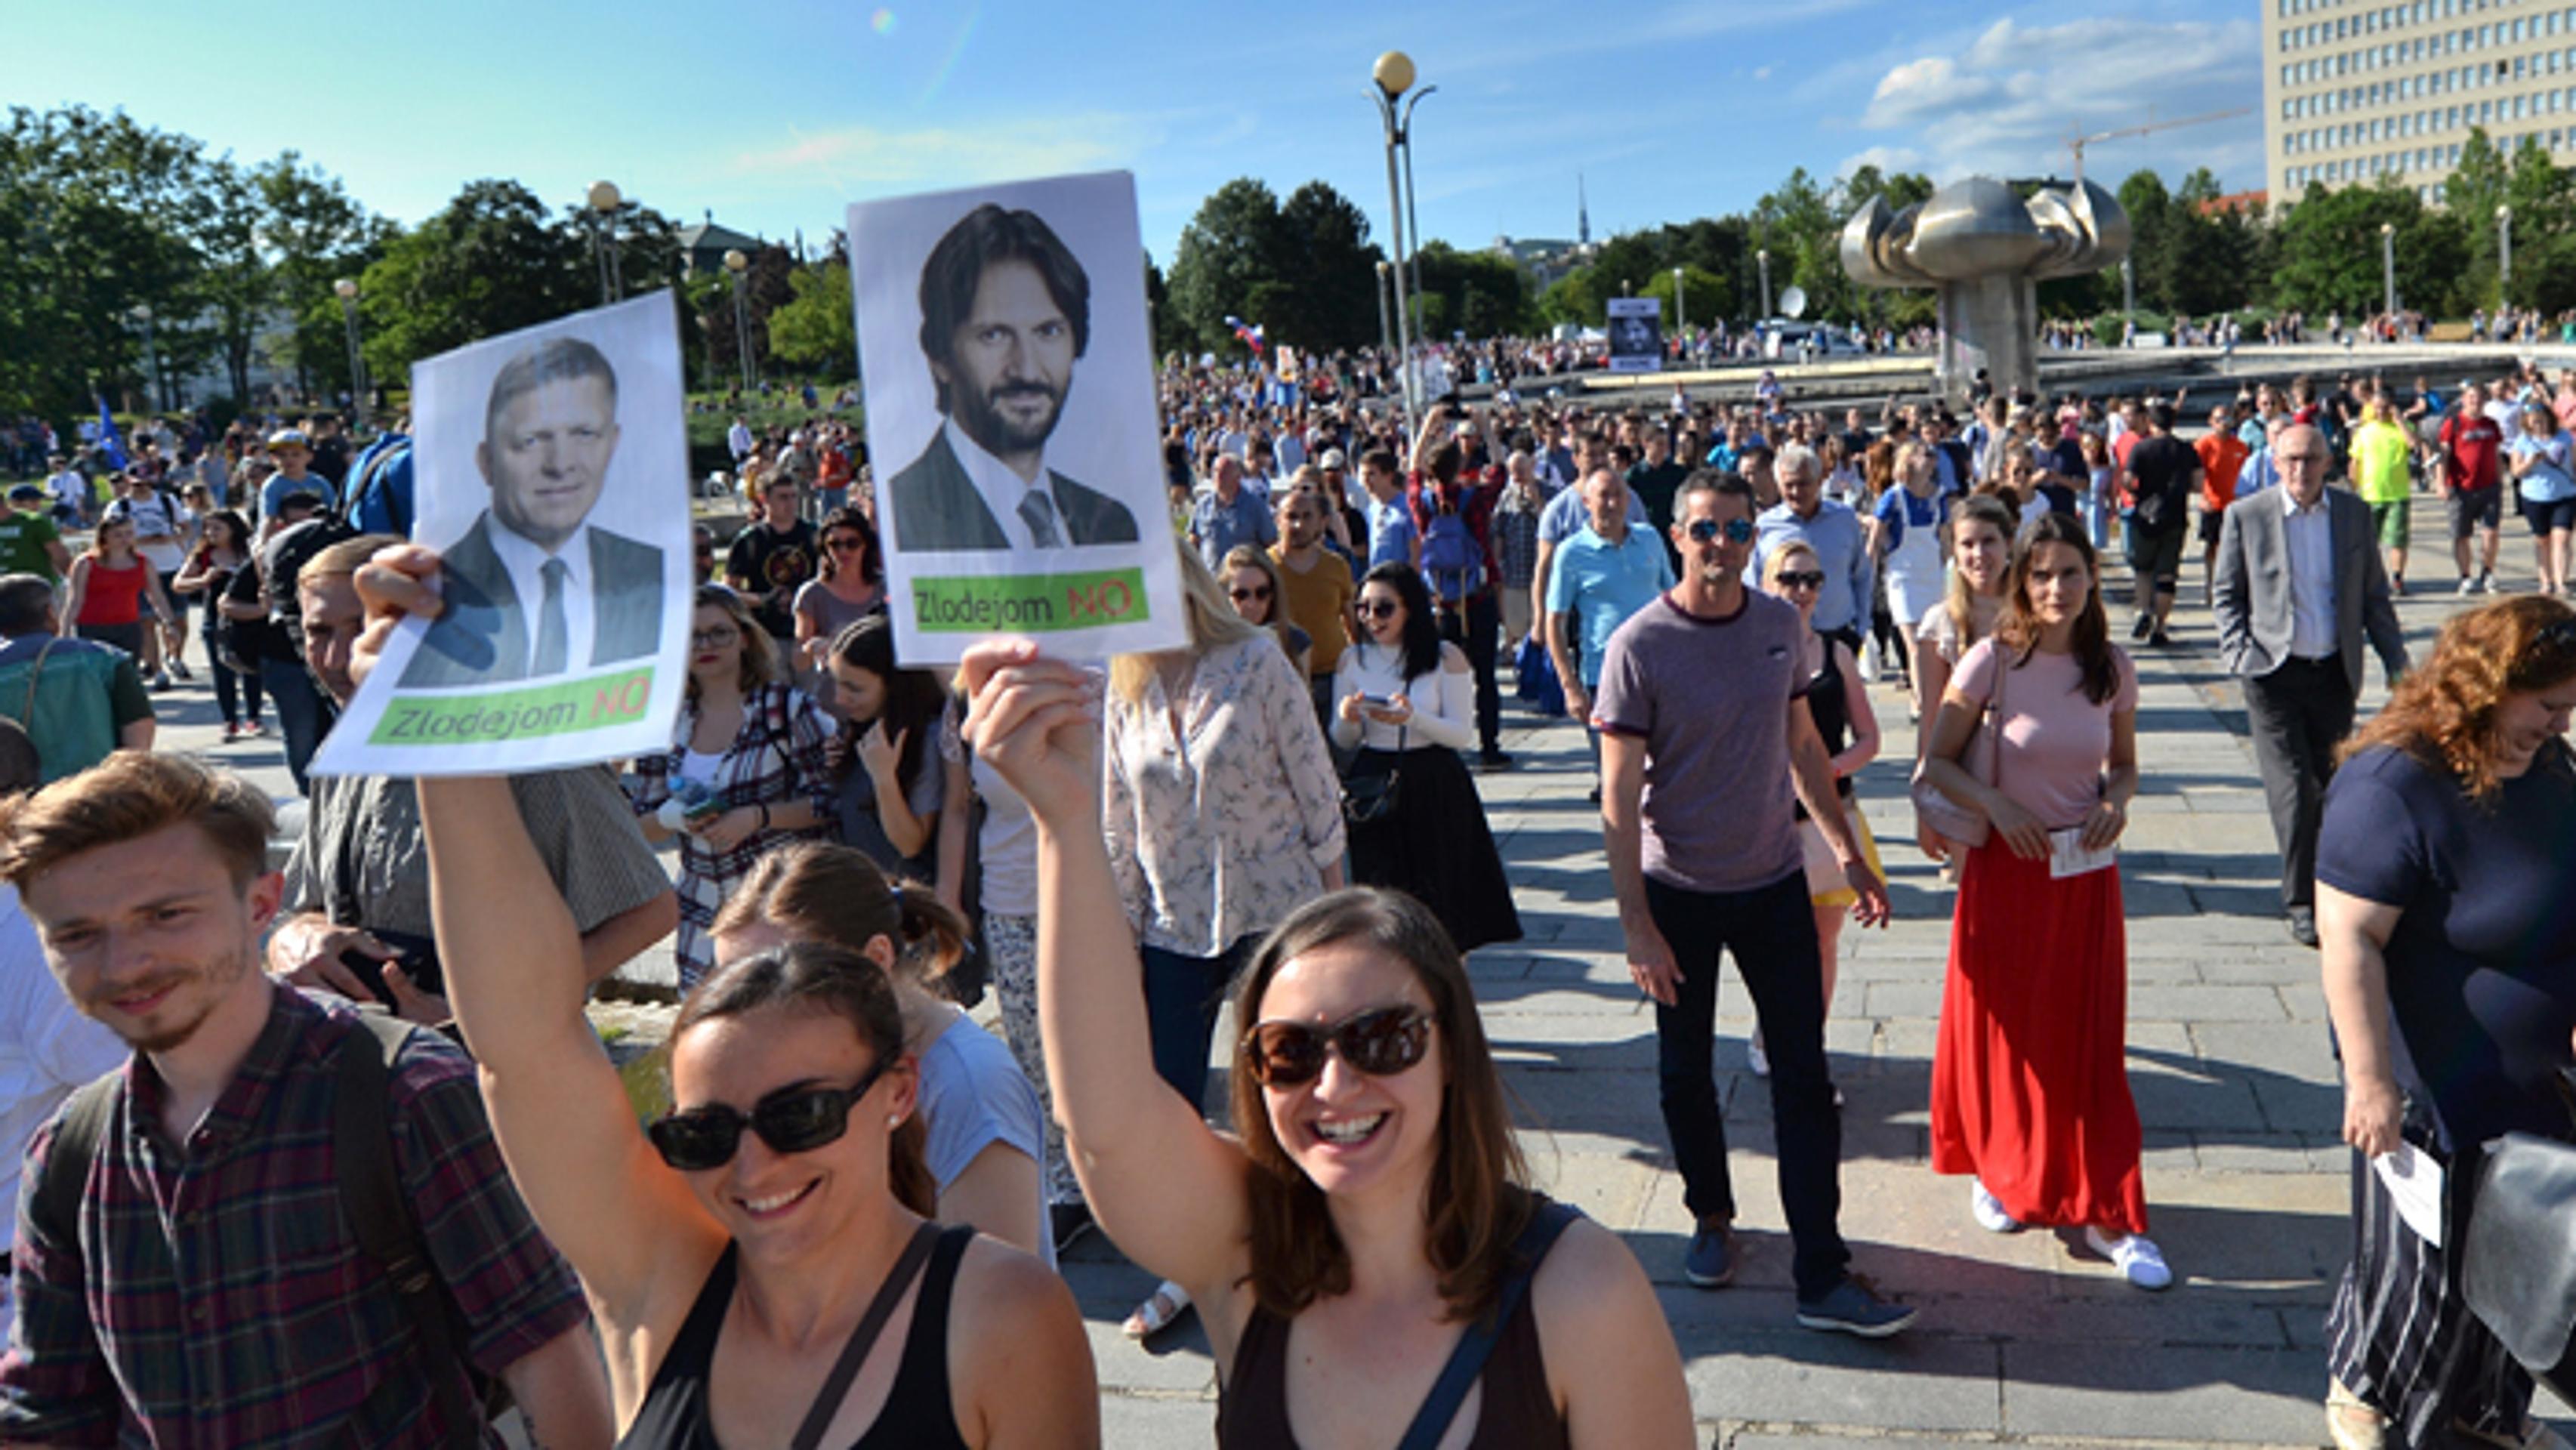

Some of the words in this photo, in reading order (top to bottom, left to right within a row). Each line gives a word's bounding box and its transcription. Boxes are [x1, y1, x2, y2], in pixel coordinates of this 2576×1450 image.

[915, 591, 1054, 630] Zlodejom
[1067, 578, 1132, 619] NO
[389, 700, 578, 740] Zlodejom
[589, 676, 651, 720] NO
